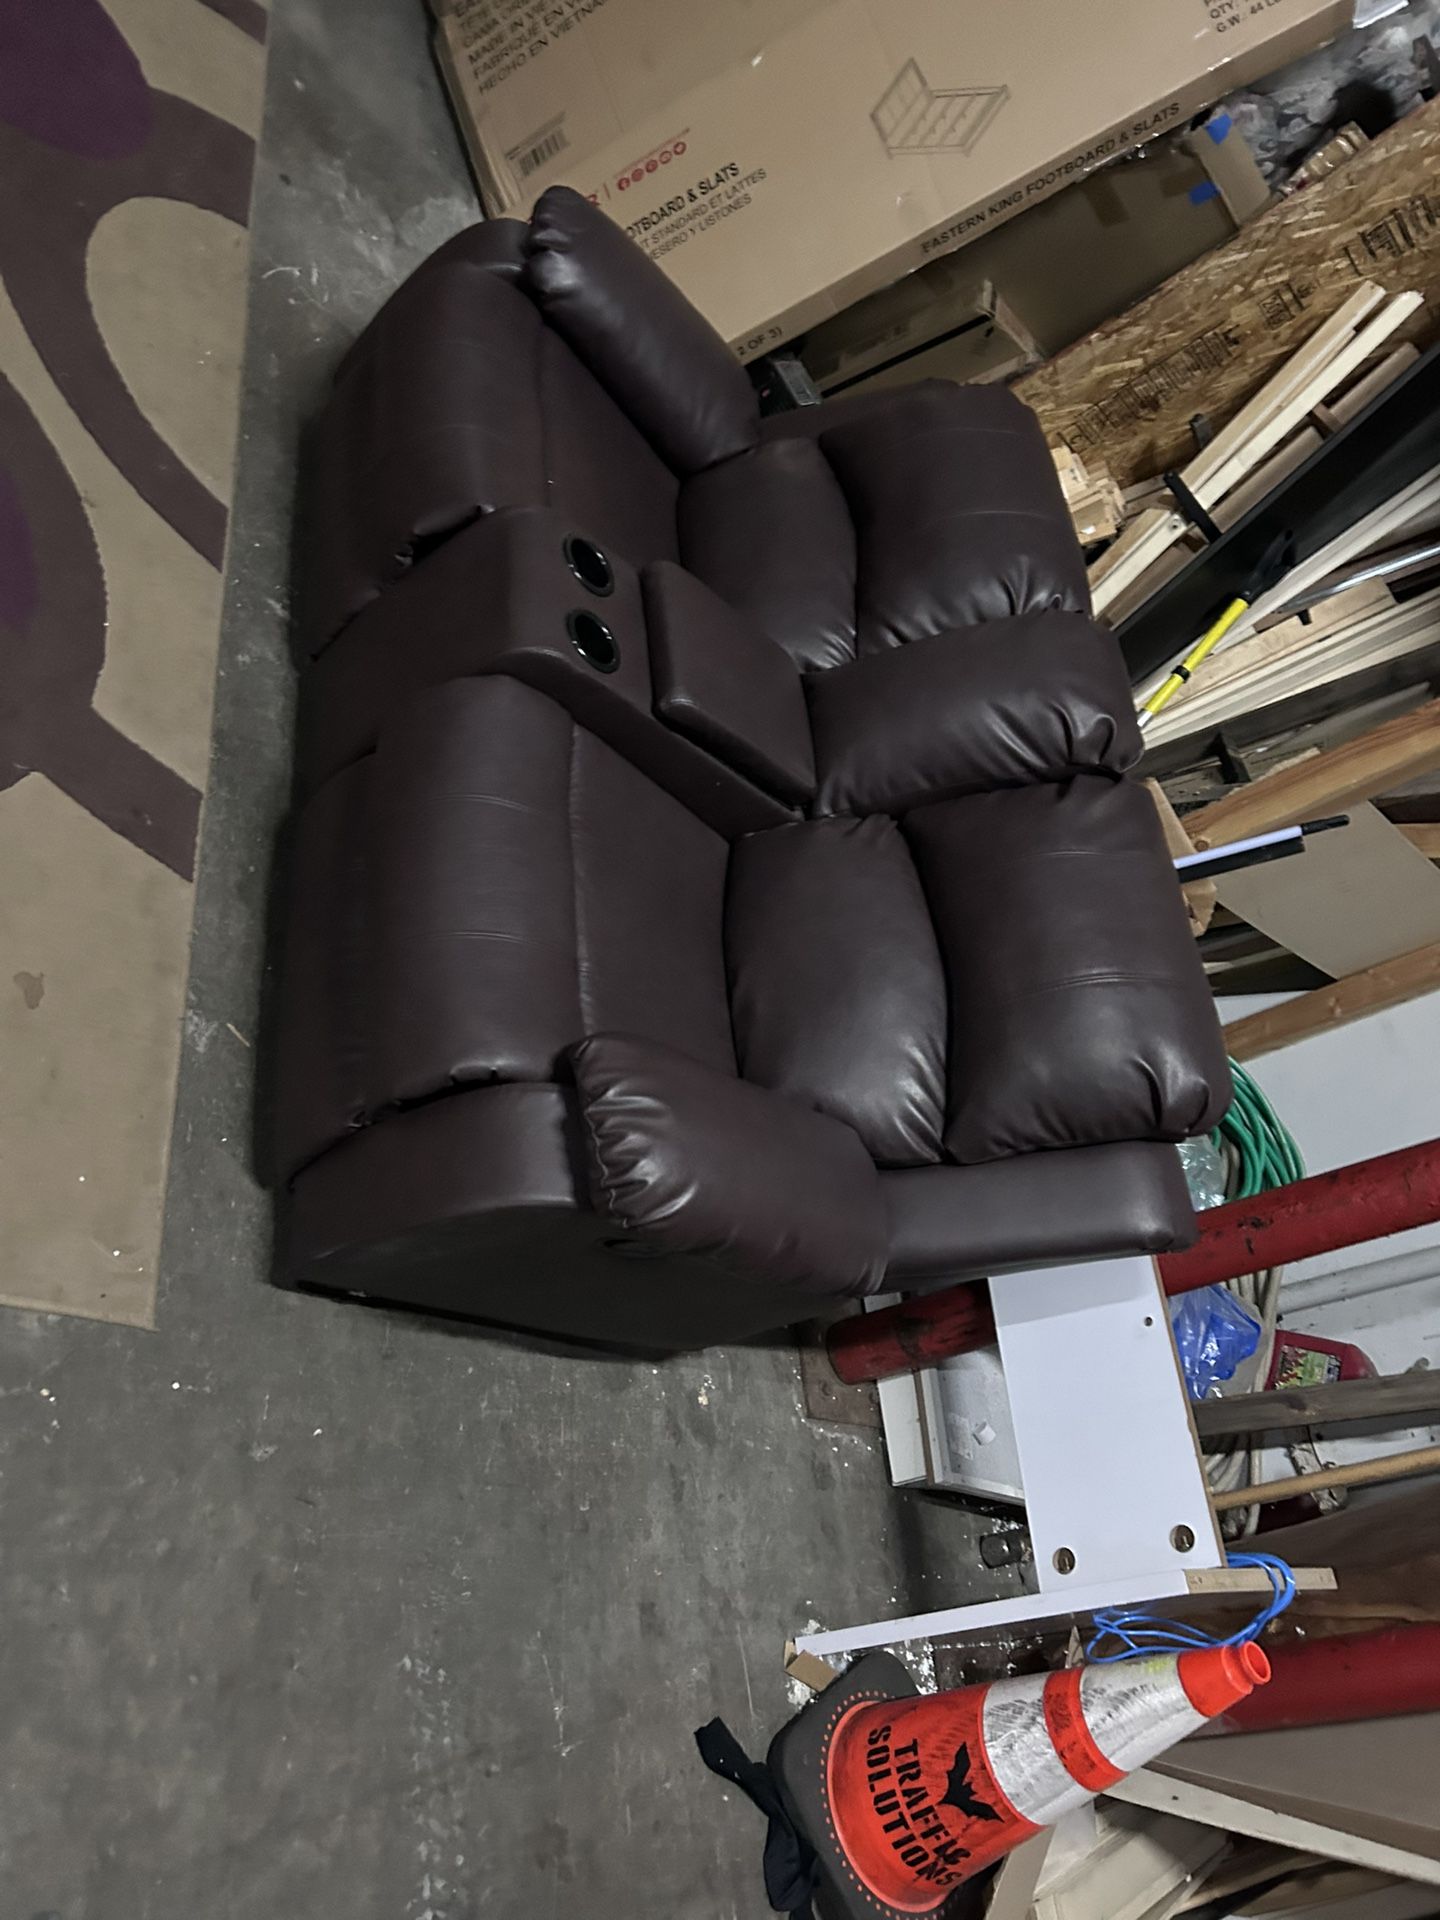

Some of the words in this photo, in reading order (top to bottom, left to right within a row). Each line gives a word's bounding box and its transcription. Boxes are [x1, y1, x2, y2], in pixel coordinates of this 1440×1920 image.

[478, 52, 526, 95] HECHO
[529, 35, 549, 57] EN
[550, 0, 608, 38] VIETNA
[543, 5, 564, 26] EN
[624, 195, 686, 239] OTBOARD
[687, 188, 699, 203] &
[698, 162, 740, 195] SLATS
[650, 204, 709, 245] STANDARD
[709, 192, 723, 210] ET
[725, 167, 768, 199] LATTES
[920, 209, 986, 254] EASTERN
[987, 191, 1024, 217] KING
[1025, 137, 1116, 197] FOOTBOARD
[1118, 130, 1130, 145] &
[1132, 101, 1181, 137] SLATS
[650, 232, 688, 261] ESERO
[699, 192, 752, 231] LISTONES
[747, 334, 766, 350] OF
[867, 1725, 962, 1886] SOLUTIONS
[894, 1738, 971, 1866] TRAFFIC
